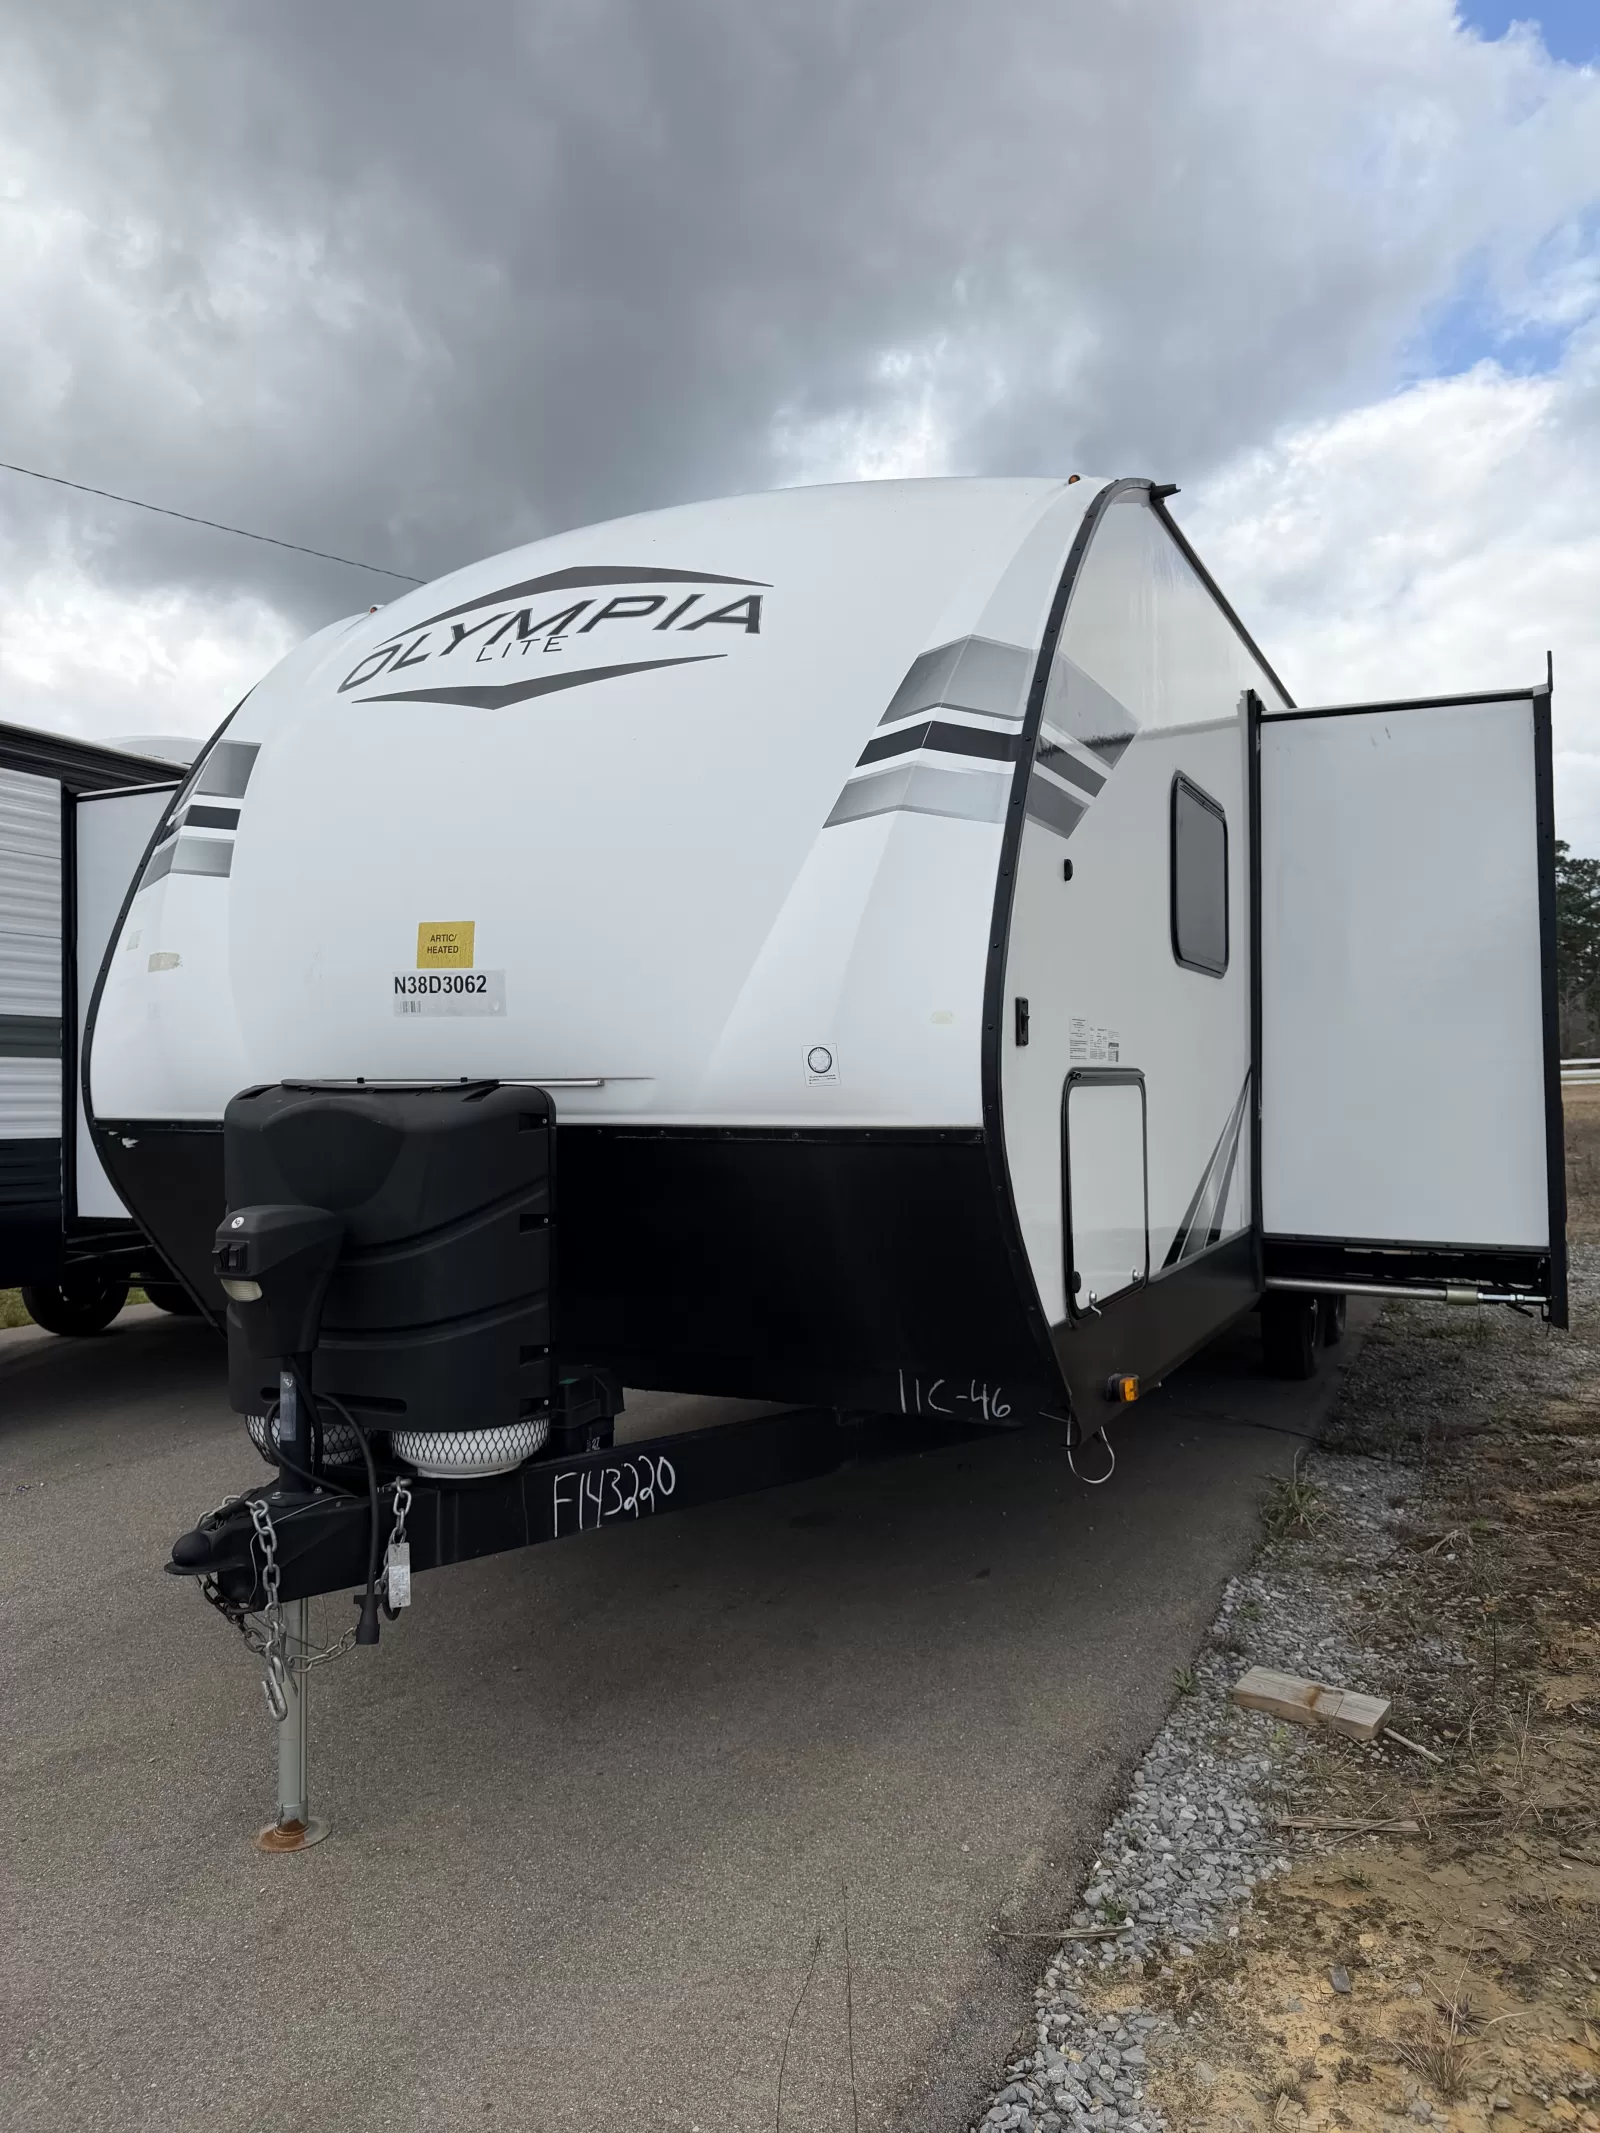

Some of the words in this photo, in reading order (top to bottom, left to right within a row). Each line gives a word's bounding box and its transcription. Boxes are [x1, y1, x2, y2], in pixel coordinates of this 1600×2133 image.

[337, 593, 765, 694] OLYMPIA
[475, 634, 570, 663] LITE
[430, 933, 458, 943] ARTIC/
[426, 945, 459, 954] HEATED
[394, 975, 487, 994] N38D3062
